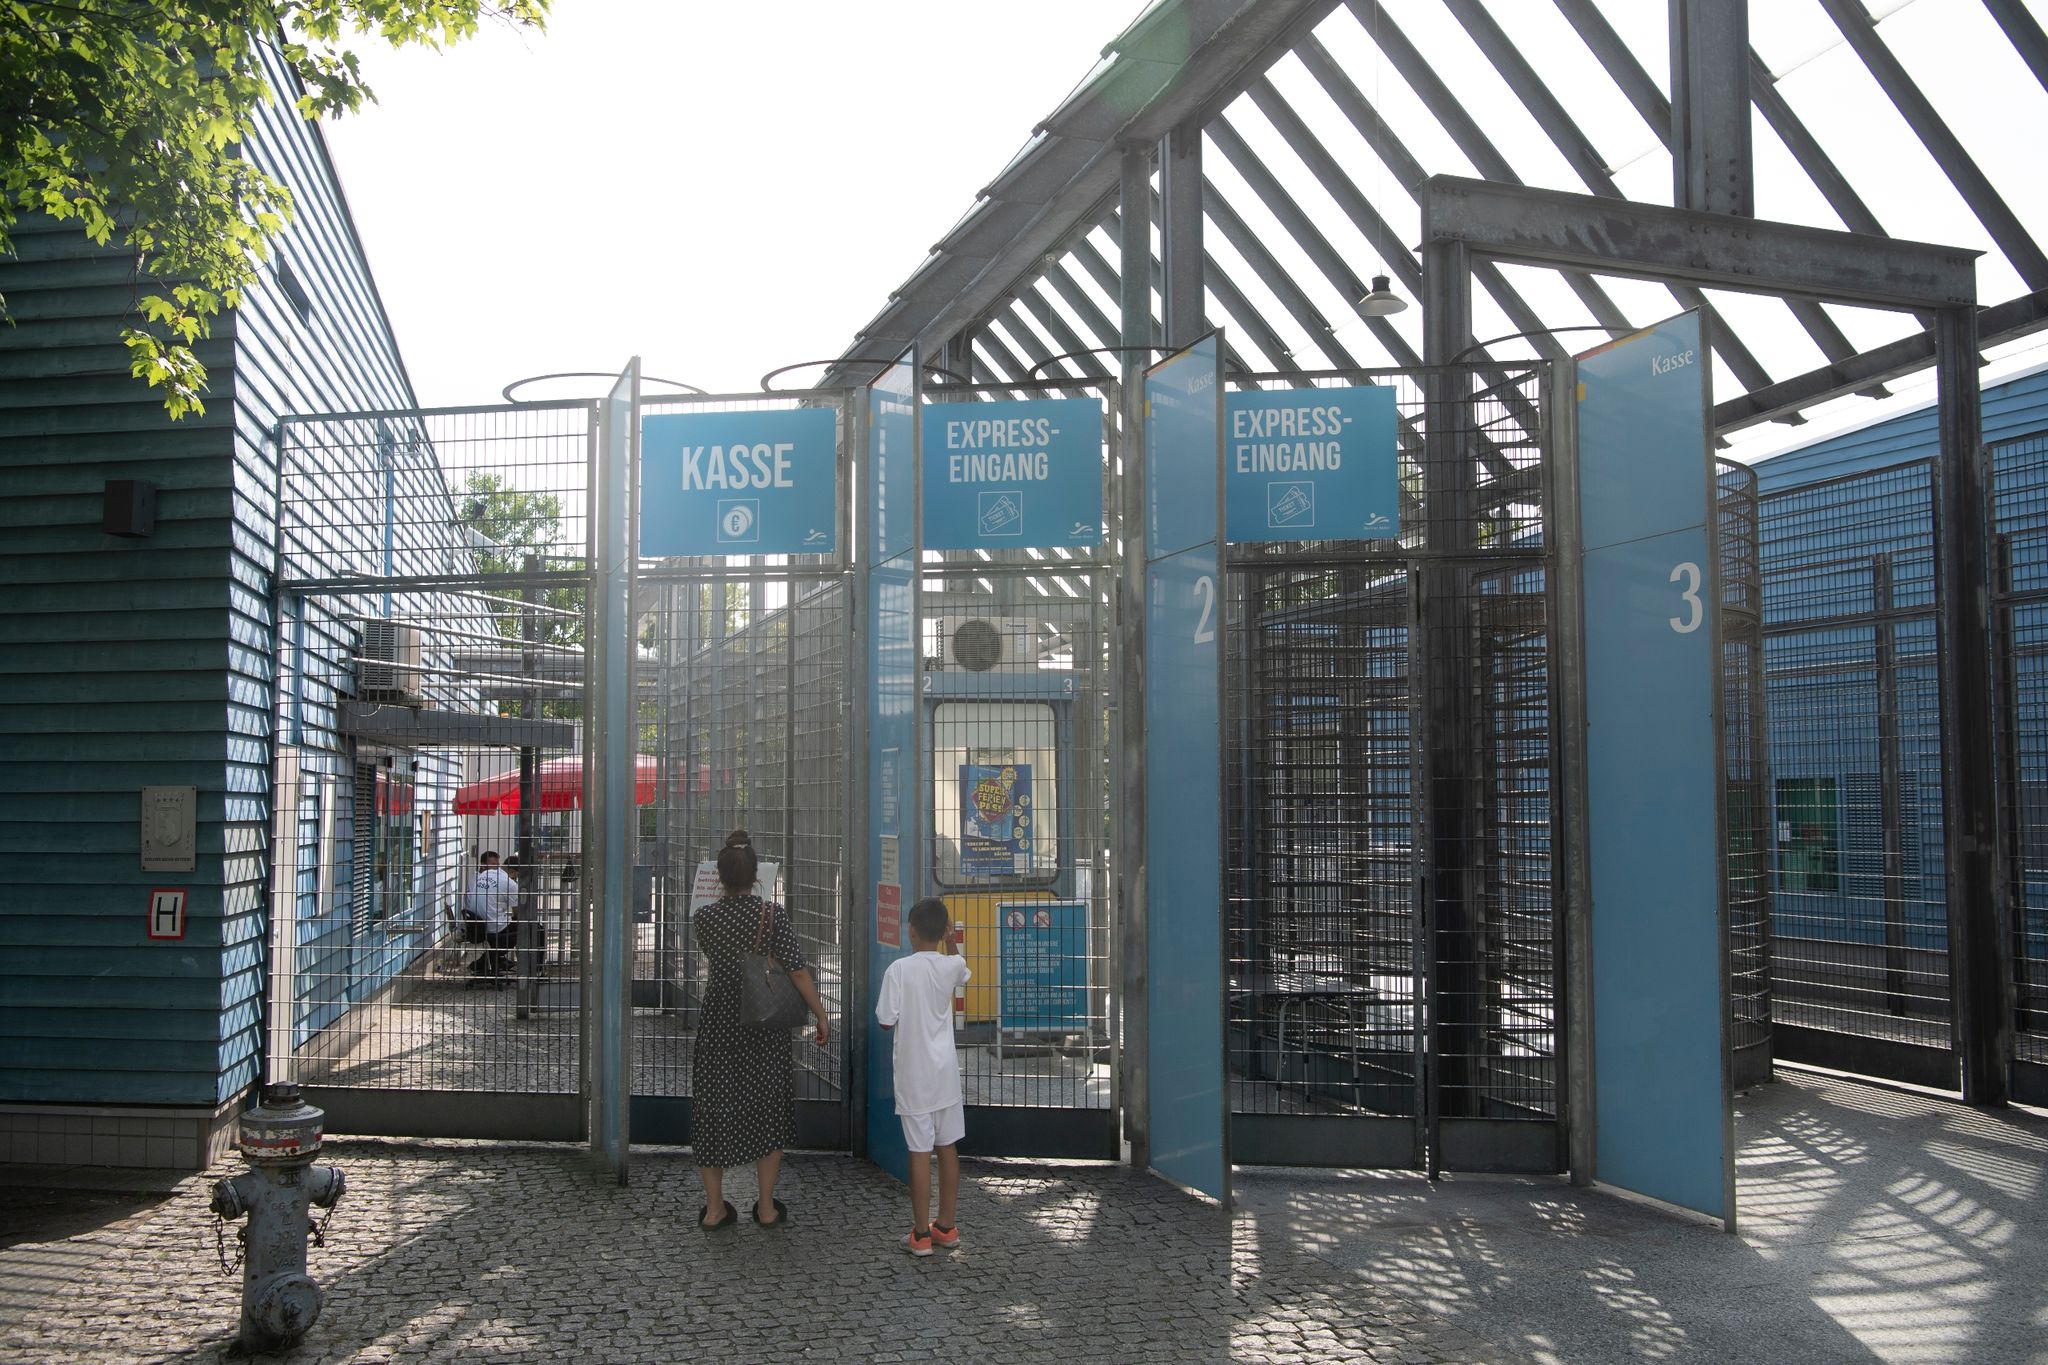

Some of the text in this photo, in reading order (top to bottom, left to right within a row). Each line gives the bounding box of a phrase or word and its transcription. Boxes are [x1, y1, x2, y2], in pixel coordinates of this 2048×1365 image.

[1651, 350, 1693, 377] Kasse
[946, 417, 1061, 449] EXPRESS-
[1232, 406, 1353, 439] EXPRESS-
[681, 443, 794, 491] KASSE
[949, 452, 1049, 483] EINGANG
[1236, 440, 1342, 474] EINGANG
[1193, 575, 1214, 645] 2
[1669, 561, 1703, 634] 3
[922, 675, 932, 692] 2
[1063, 678, 1073, 694] 3
[155, 896, 179, 932] H
